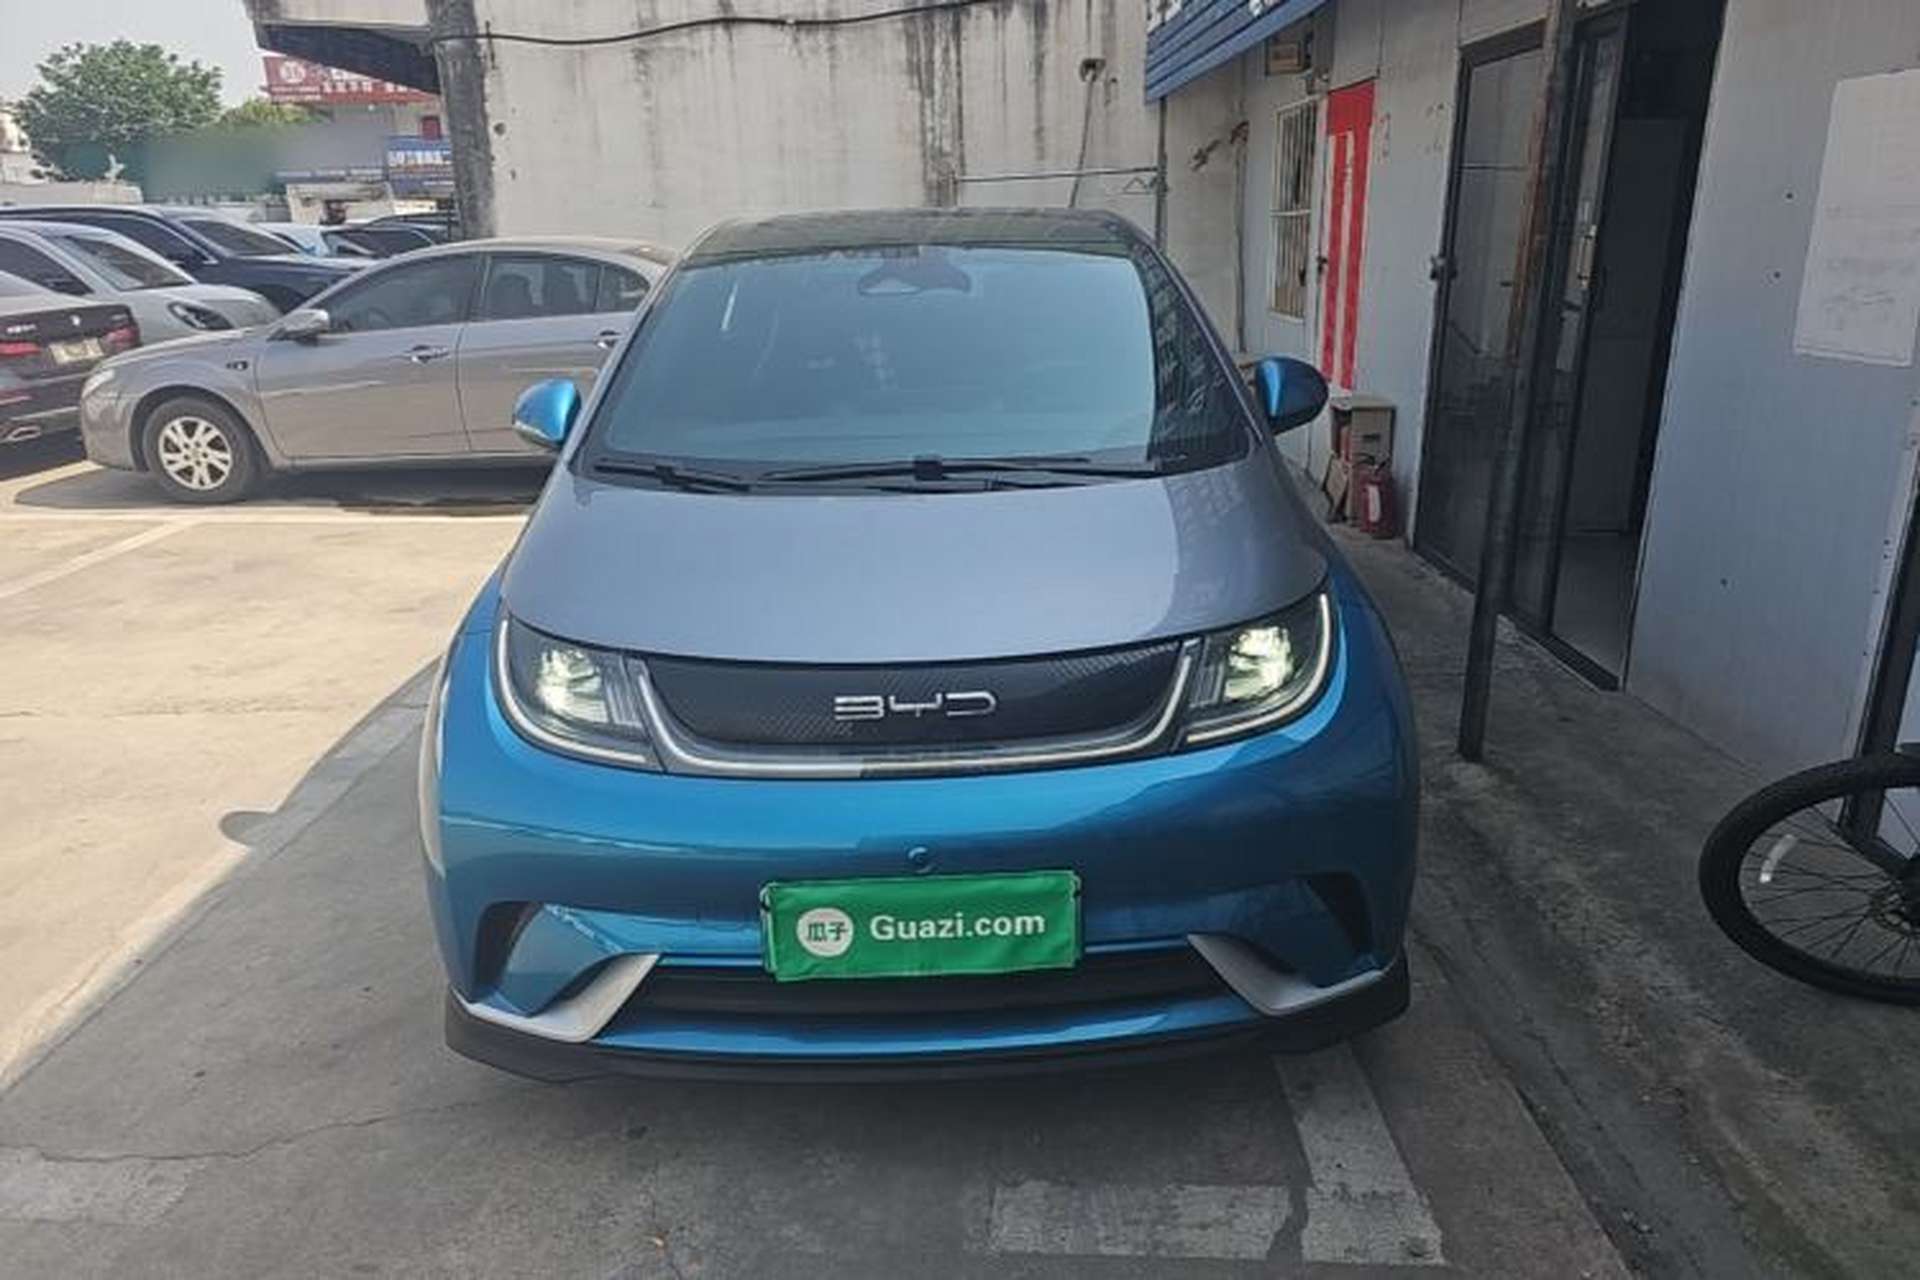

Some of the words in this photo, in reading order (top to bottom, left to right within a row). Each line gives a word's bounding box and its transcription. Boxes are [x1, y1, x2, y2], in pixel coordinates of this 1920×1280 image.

[834, 692, 997, 721] BYD
[806, 921, 848, 942] 瓜子
[870, 912, 1046, 941] Guazi.com
